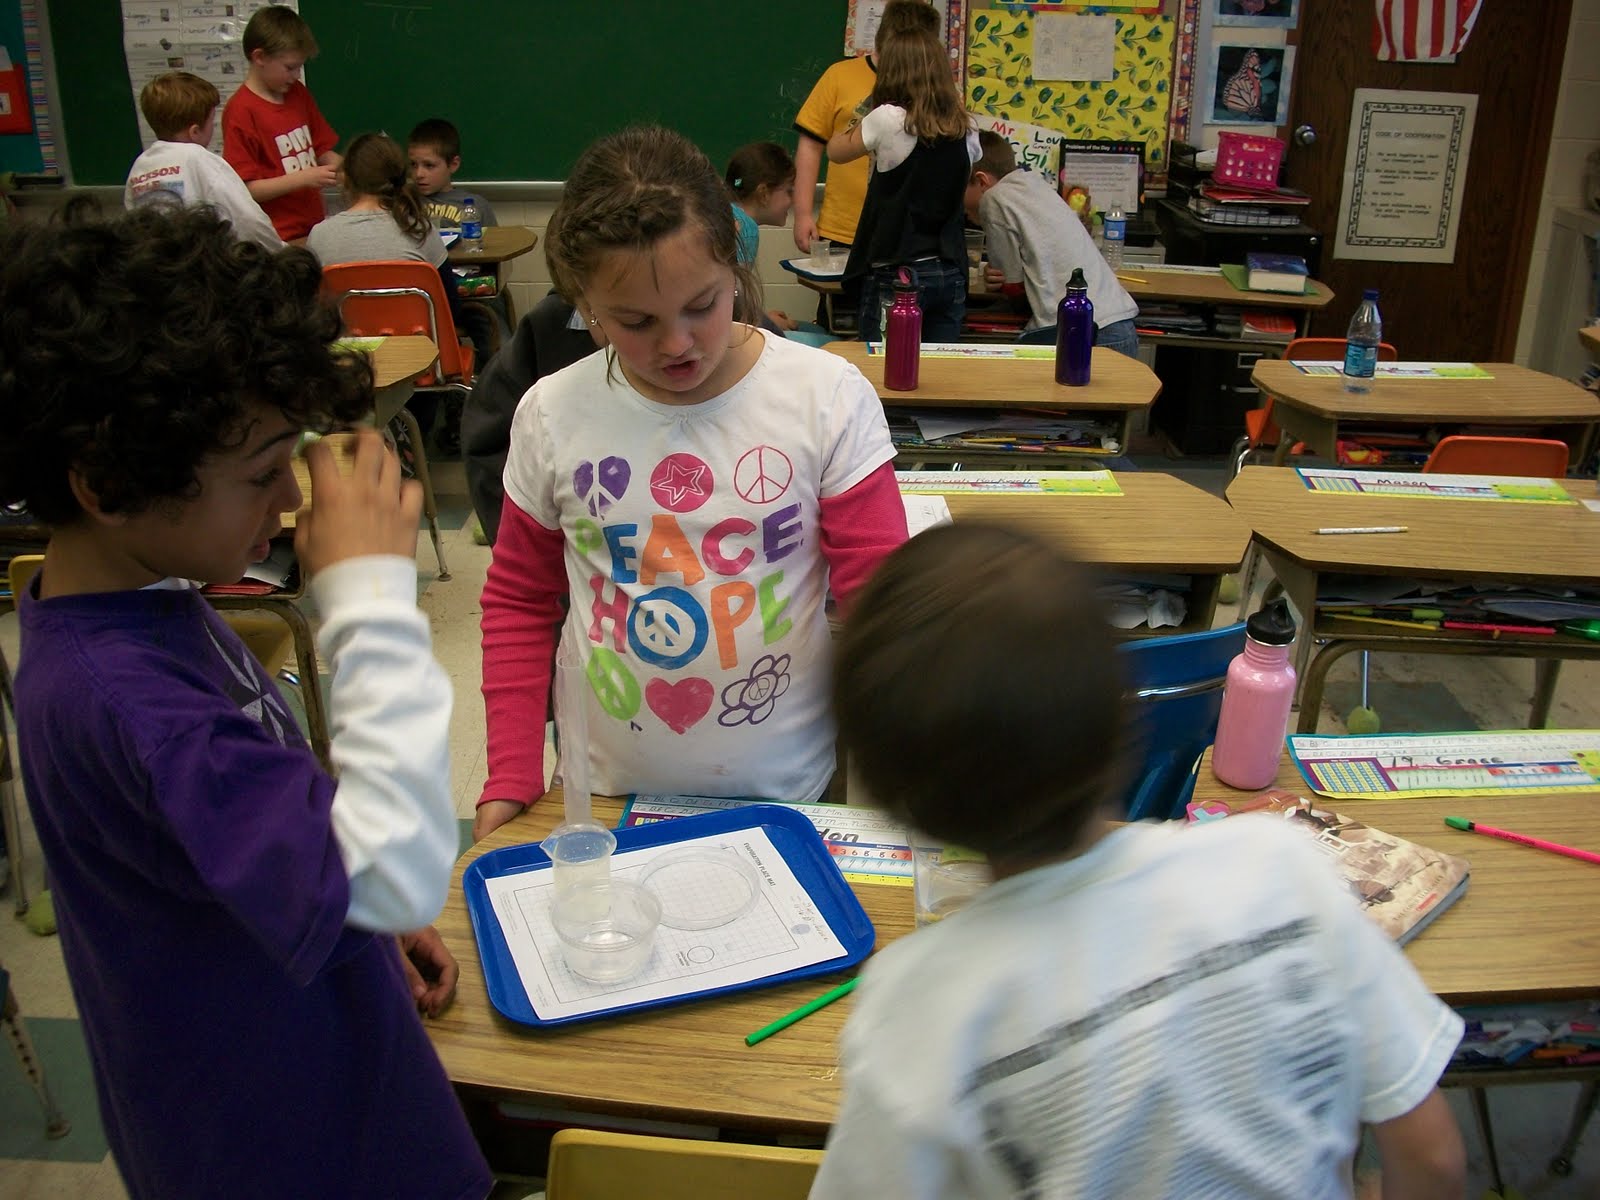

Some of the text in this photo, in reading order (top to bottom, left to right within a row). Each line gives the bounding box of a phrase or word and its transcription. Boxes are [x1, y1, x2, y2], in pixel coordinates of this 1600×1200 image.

[991, 121, 1015, 135] Mr
[1035, 131, 1064, 144] Lov
[1377, 479, 1429, 487] Mason
[576, 502, 803, 586] PEACE
[588, 569, 792, 671] HOPE
[1436, 756, 1503, 764] Grace
